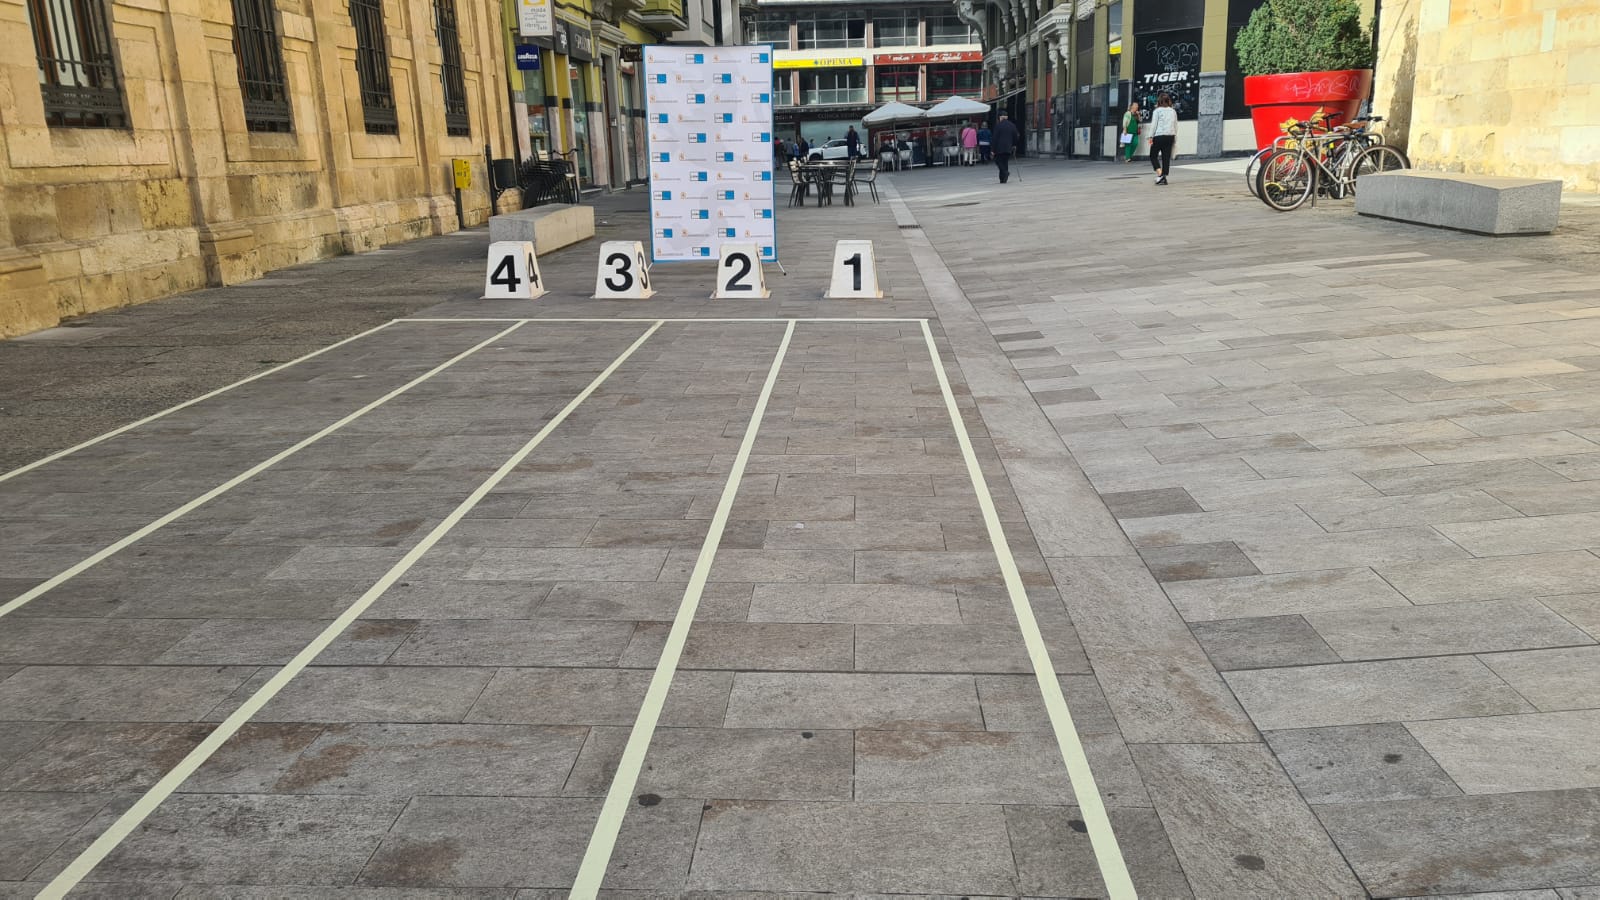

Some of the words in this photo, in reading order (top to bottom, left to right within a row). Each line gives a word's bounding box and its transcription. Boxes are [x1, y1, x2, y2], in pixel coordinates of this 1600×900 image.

[1144, 71, 1188, 83] TIGER
[490, 254, 521, 293] 4
[528, 252, 539, 289] 4
[604, 252, 634, 292] 3
[637, 251, 648, 290] 3
[724, 252, 753, 292] 2
[843, 253, 862, 291] 1
